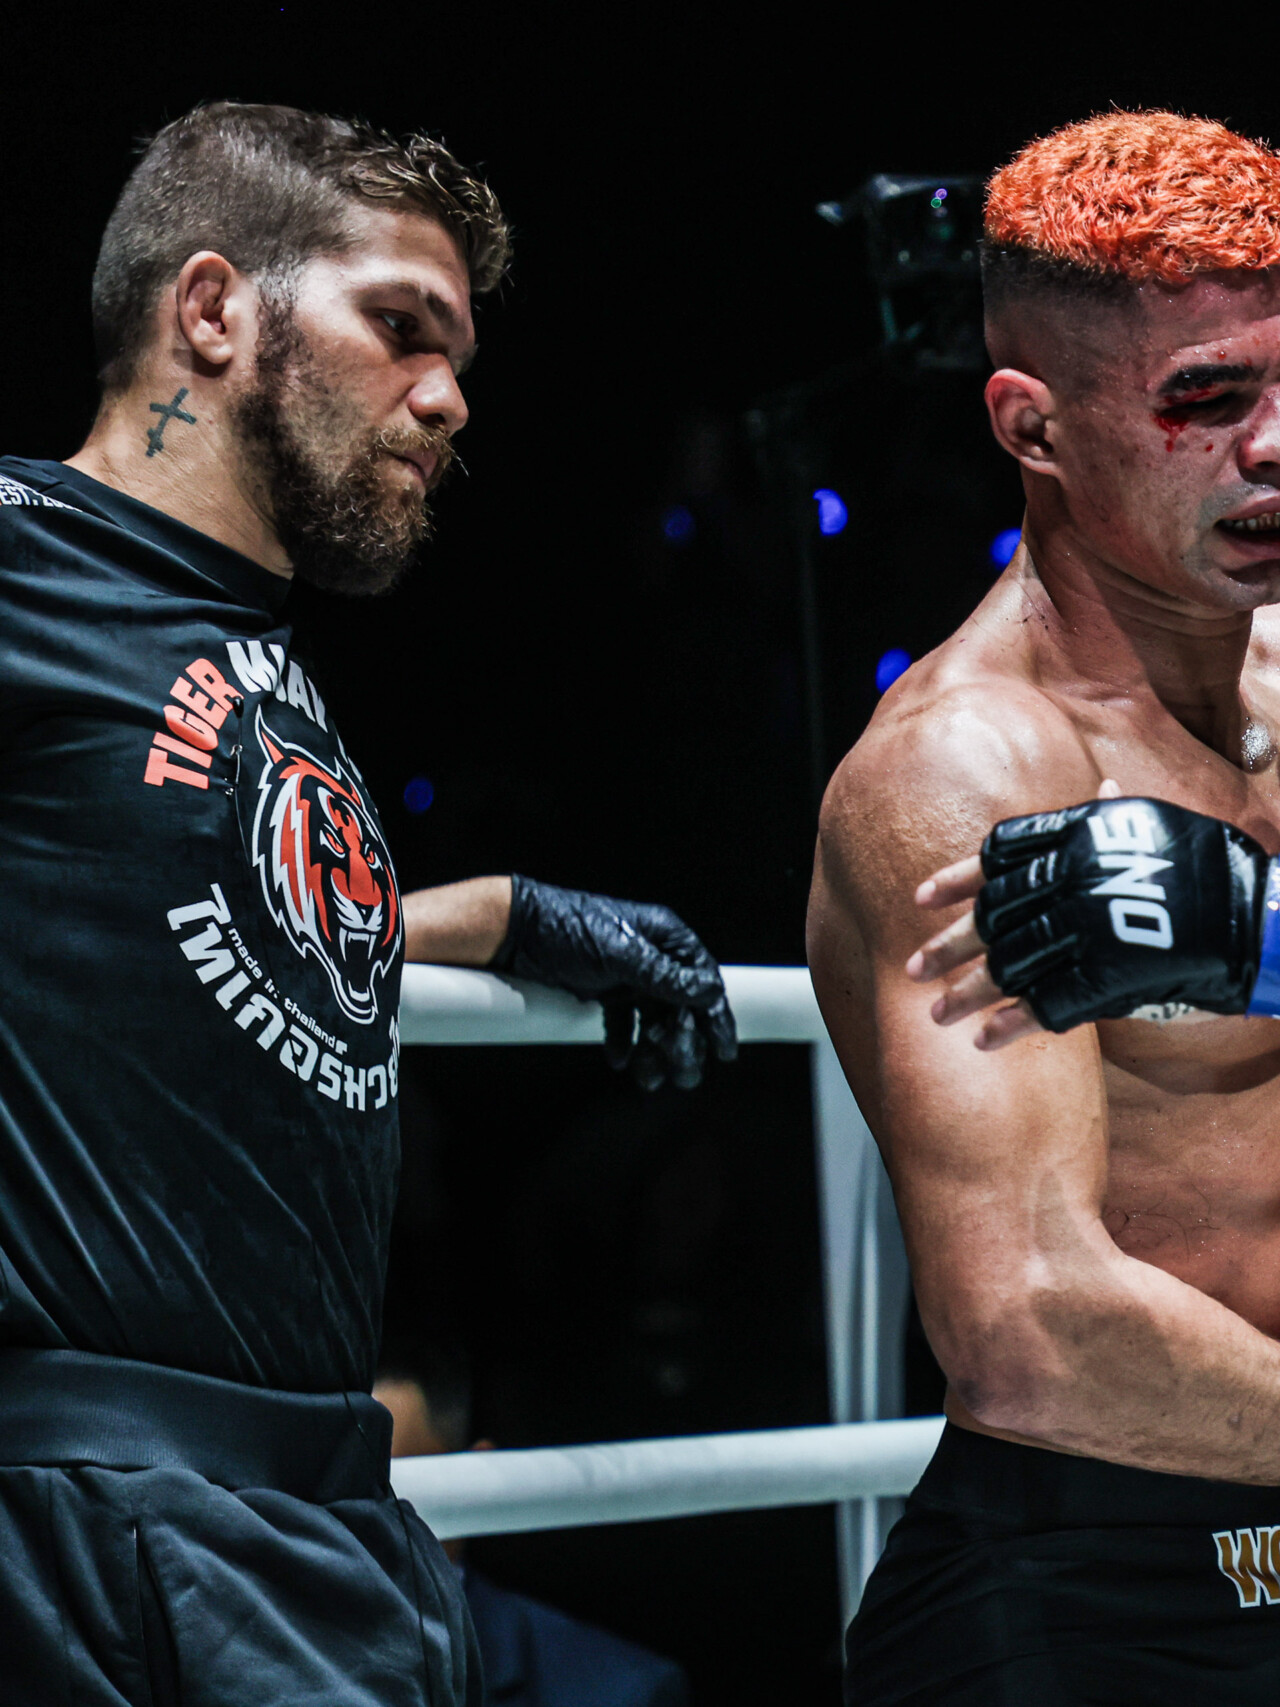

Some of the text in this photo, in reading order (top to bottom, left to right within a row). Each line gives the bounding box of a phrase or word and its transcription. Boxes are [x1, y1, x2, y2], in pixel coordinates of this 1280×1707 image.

[143, 658, 244, 790] TIGER
[1087, 815, 1176, 950] ONE
[228, 928, 263, 980] made
[284, 998, 337, 1049] thailand
